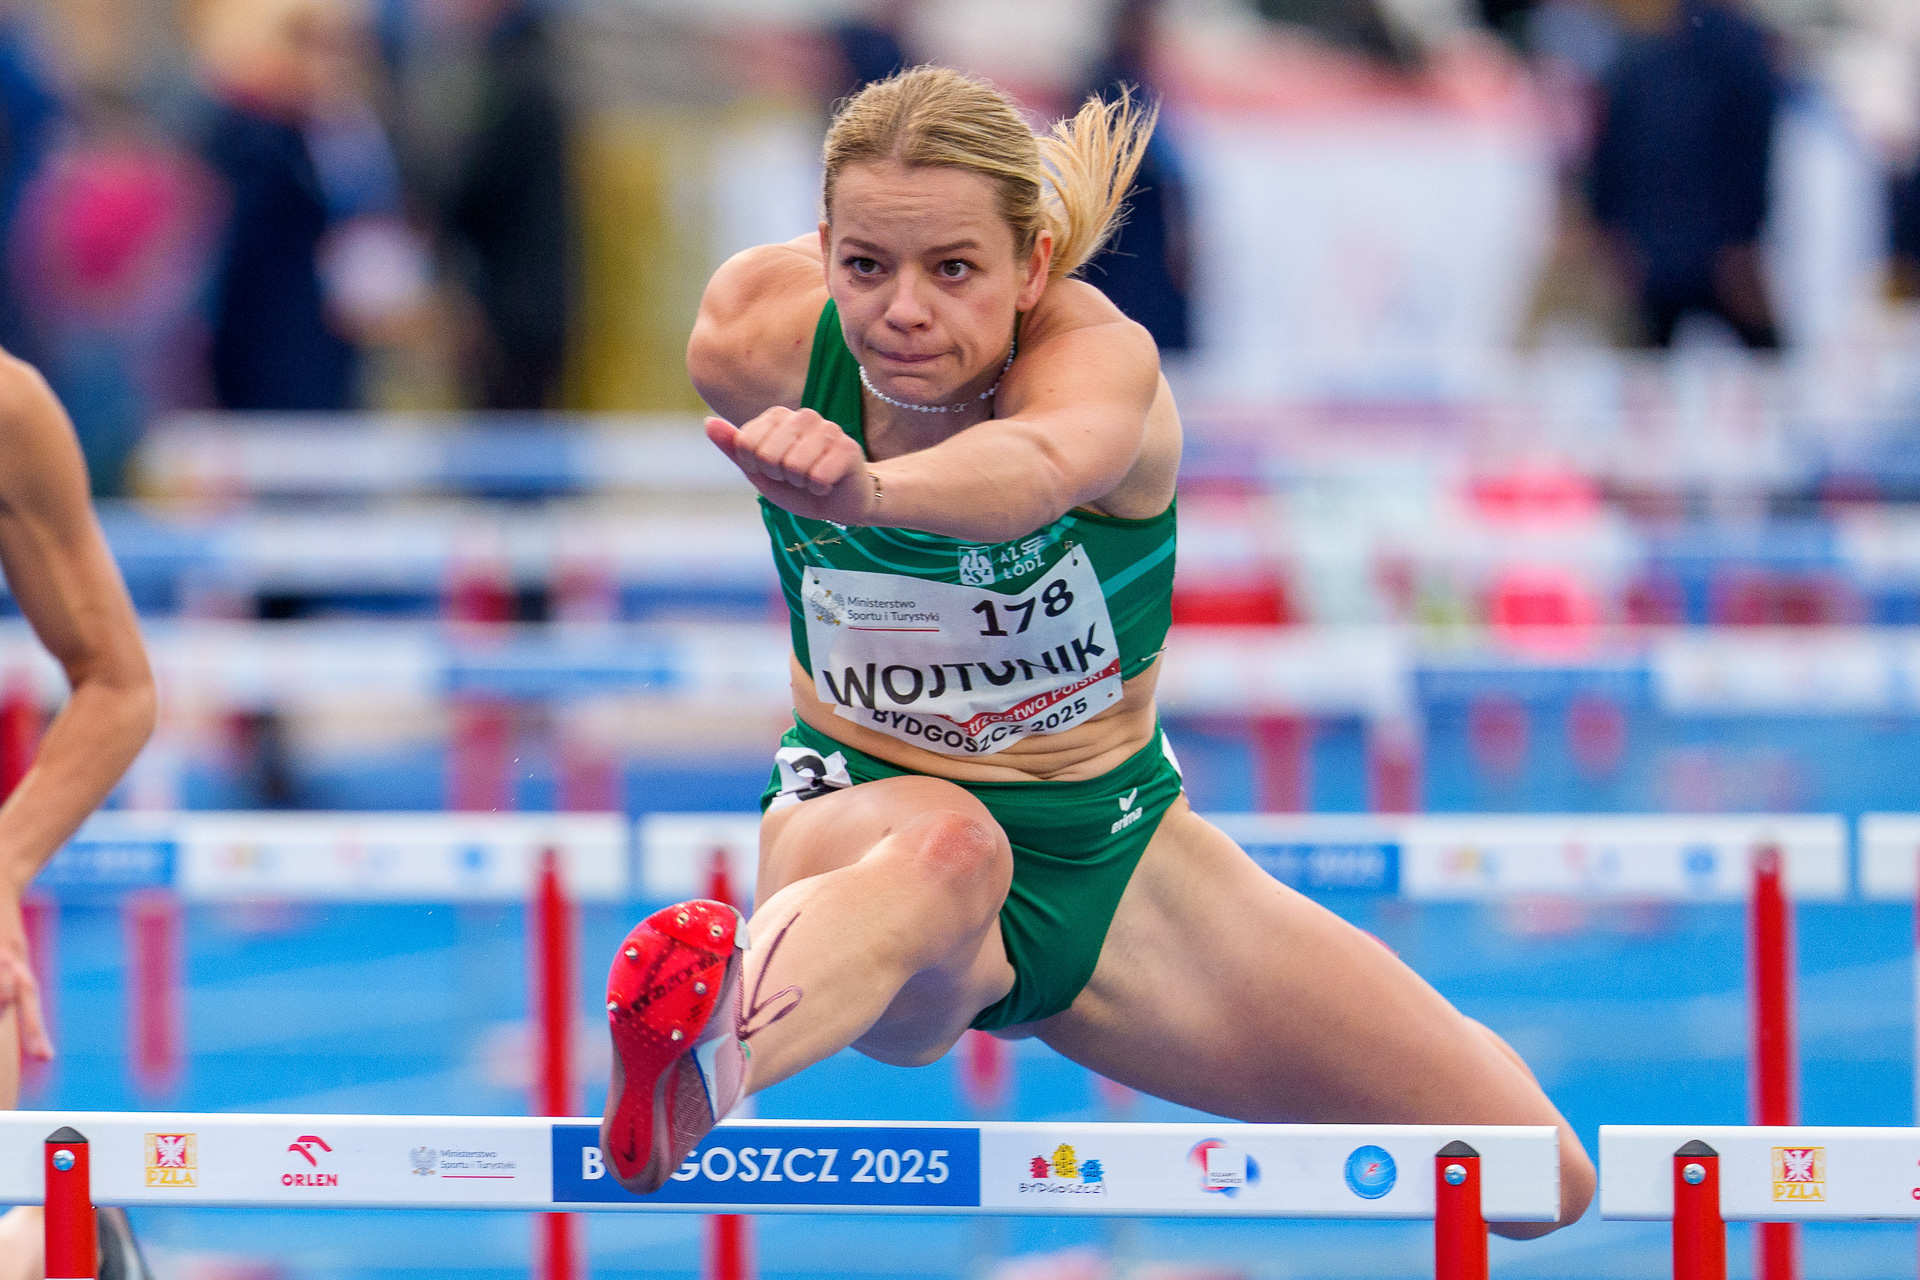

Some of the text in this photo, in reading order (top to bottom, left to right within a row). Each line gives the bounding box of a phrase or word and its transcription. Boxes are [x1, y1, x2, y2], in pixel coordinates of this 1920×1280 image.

[847, 596, 916, 609] Ministerstwo
[971, 578, 1075, 638] 178
[847, 610, 881, 622] Sportu
[891, 611, 940, 623] Turystyki
[822, 621, 1106, 710] WOJTUNIK
[871, 697, 1088, 753] BYDGOSZCZ 2025
[581, 1146, 950, 1184] BGOSZCZ 2025
[146, 1169, 195, 1185] PZLA
[281, 1173, 339, 1187] ORLEN
[1773, 1183, 1823, 1199] PZLA
